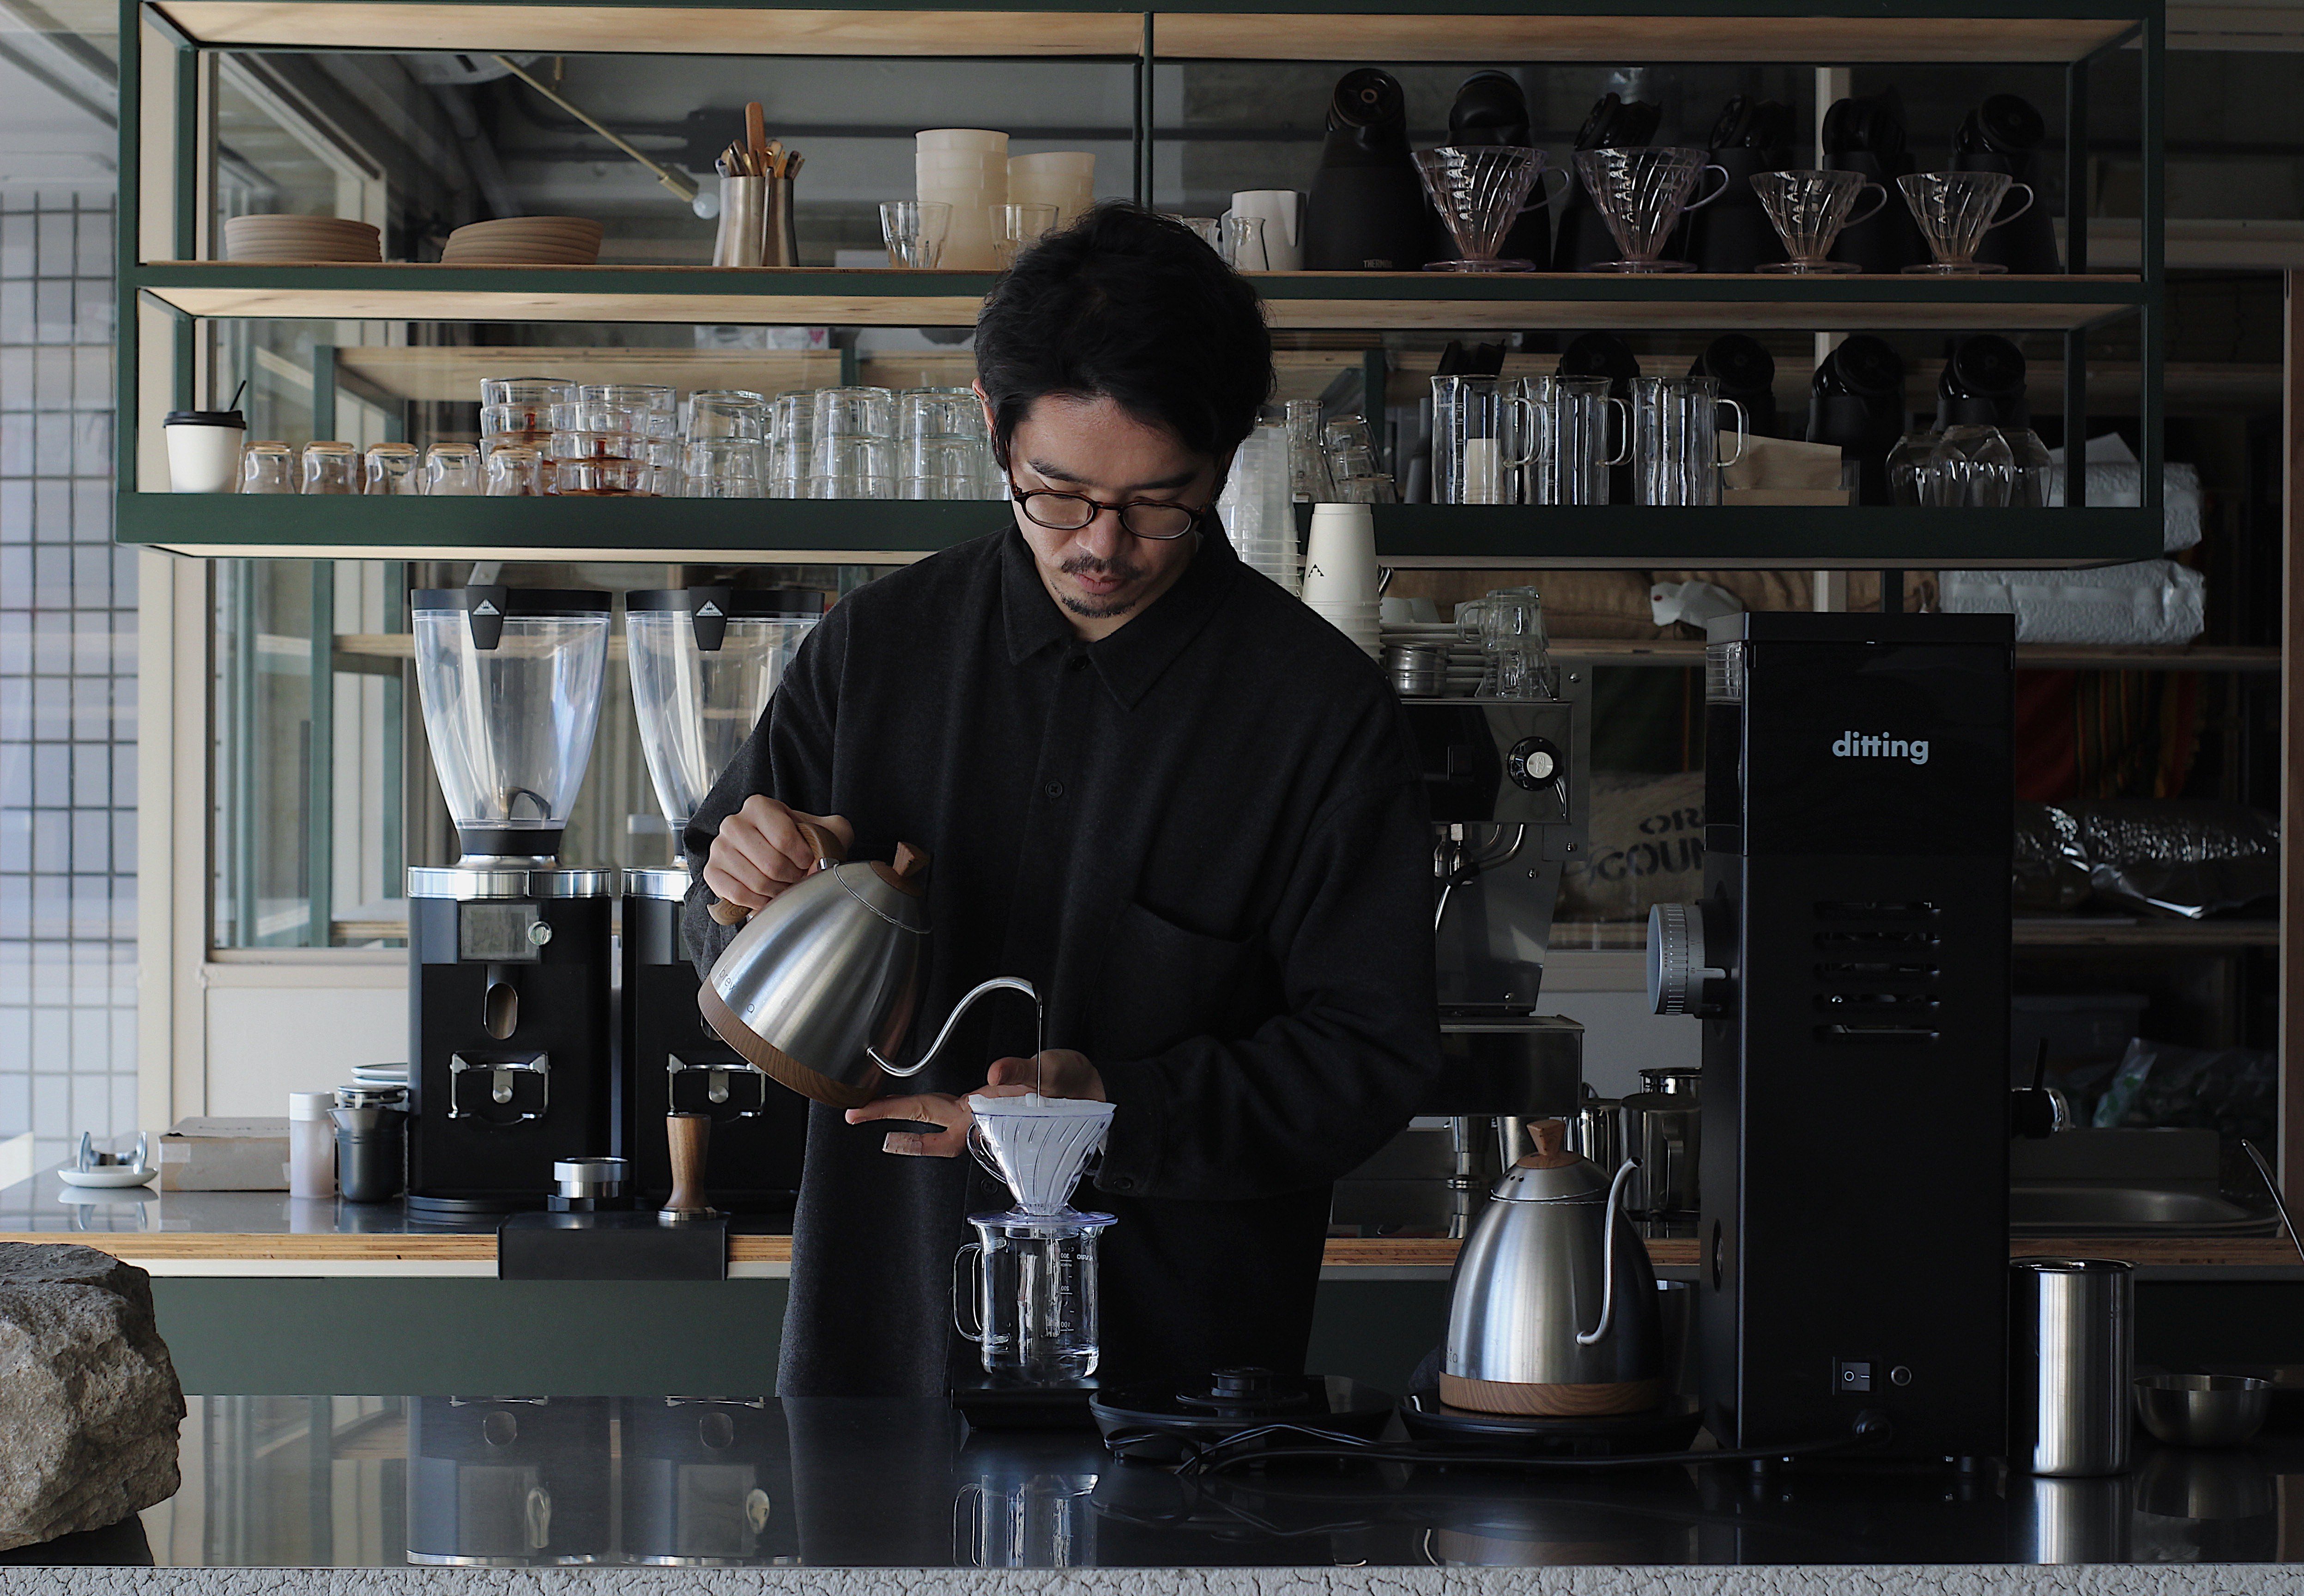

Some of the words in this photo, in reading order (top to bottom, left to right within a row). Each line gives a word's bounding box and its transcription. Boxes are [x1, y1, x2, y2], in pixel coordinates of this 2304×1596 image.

[1363, 259, 1393, 268] THERMOS
[1832, 731, 1929, 765] ditting
[1639, 805, 1705, 834] OR
